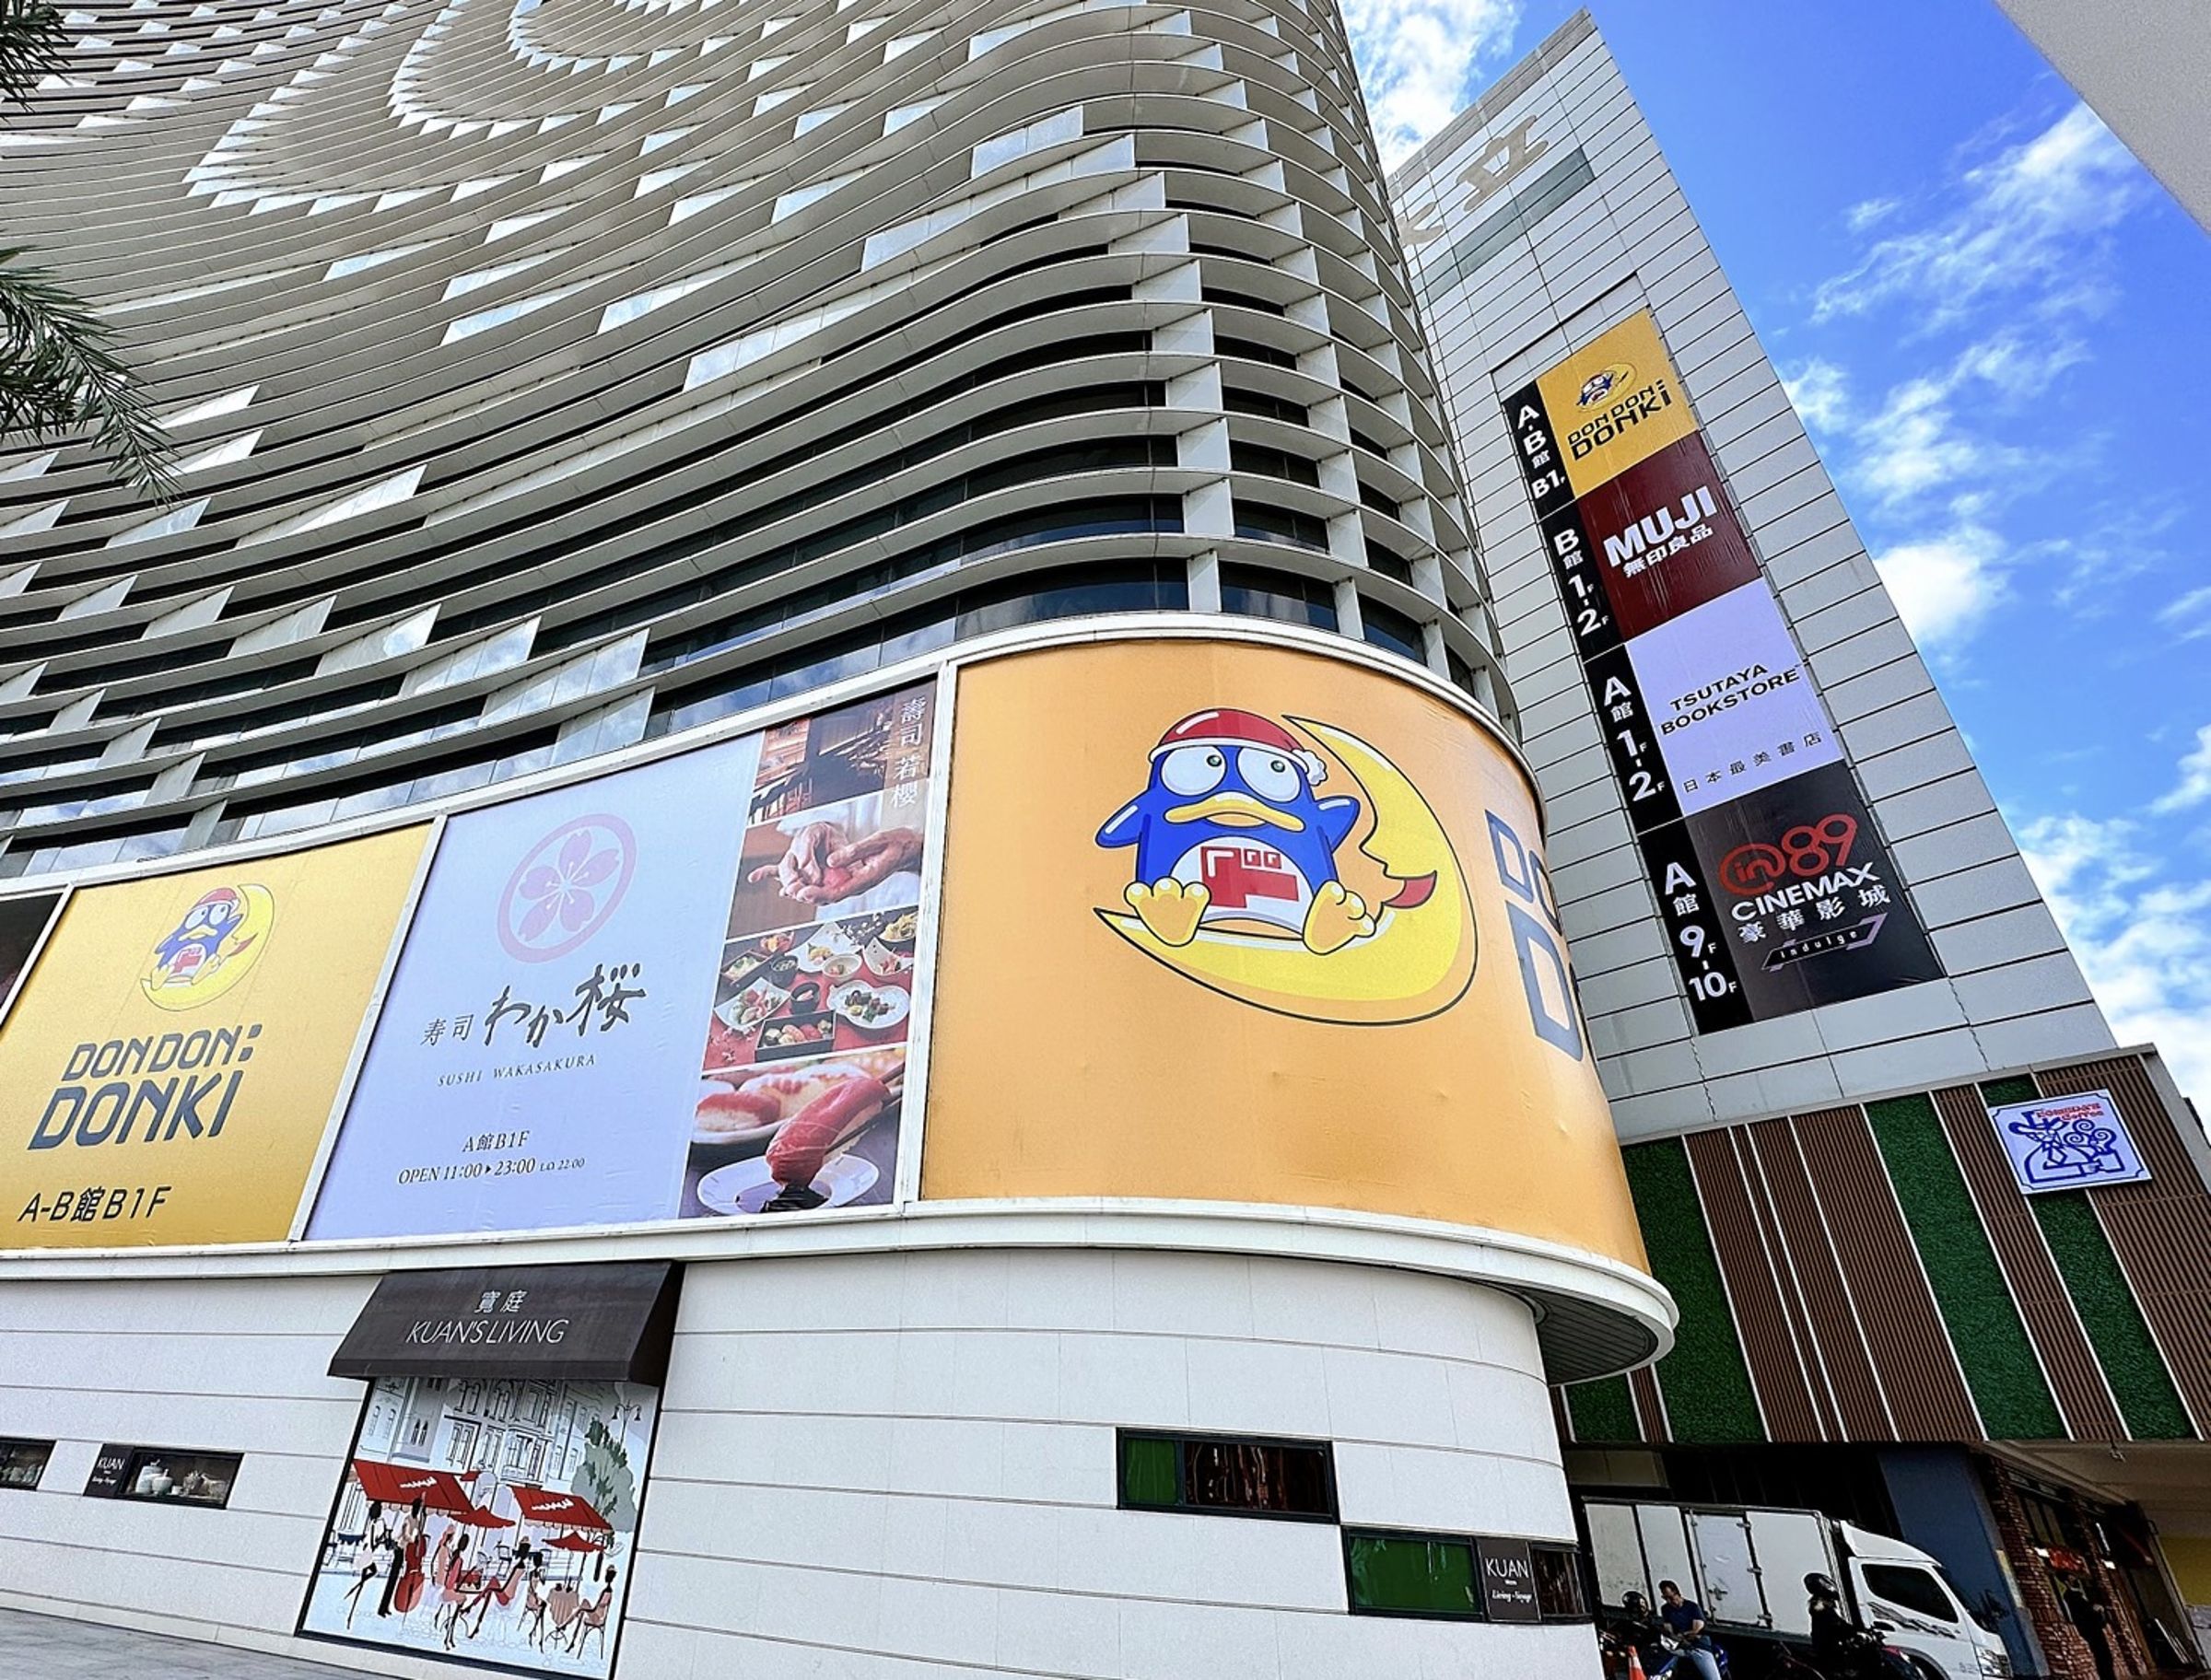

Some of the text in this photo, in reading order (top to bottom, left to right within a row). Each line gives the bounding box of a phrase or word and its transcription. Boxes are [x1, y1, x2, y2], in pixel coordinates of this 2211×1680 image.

[1568, 385, 1655, 445] DON DON
[1603, 485, 1717, 567] MUJI
[1622, 523, 1714, 578] 無印良品
[1661, 668, 1800, 736] BOOKSTORE
[1670, 664, 1768, 711] TSUTAYA
[1731, 862, 1881, 921] CINEMAX
[1737, 884, 1891, 944] 豪華影城
[420, 1013, 474, 1046] 寿司
[62, 1037, 153, 1080] DON
[438, 1055, 596, 1088] SUSHI WAKASAKURA
[28, 1070, 244, 1150] DONKI
[462, 1130, 531, 1152] A館B1F
[398, 1167, 440, 1184] OPEN
[405, 1319, 569, 1344] KUAN'S LIVING
[1484, 1558, 1529, 1579] KUAN
